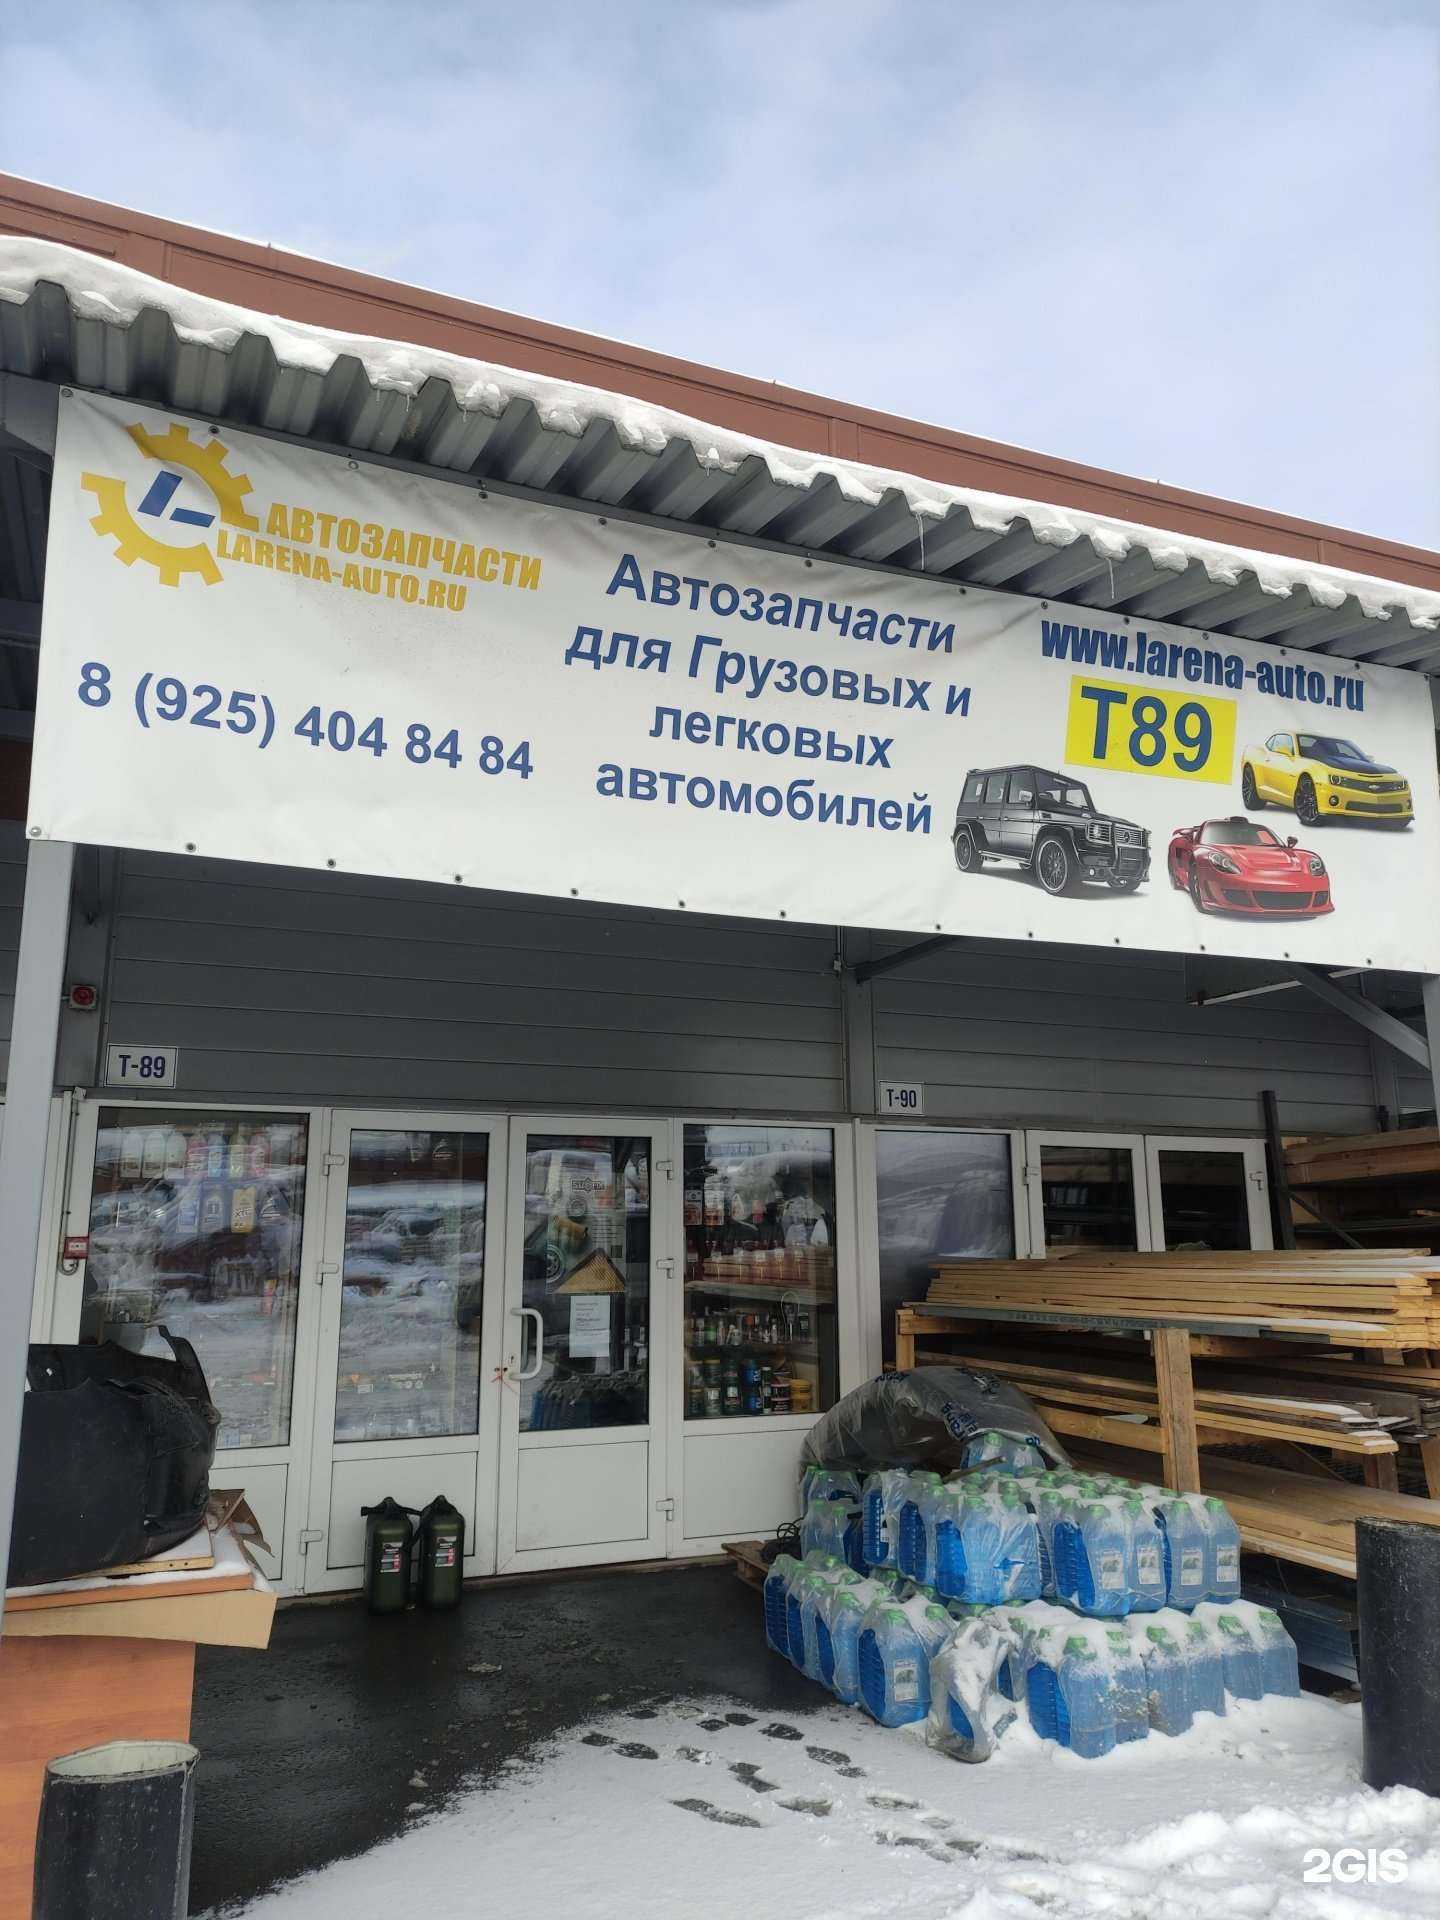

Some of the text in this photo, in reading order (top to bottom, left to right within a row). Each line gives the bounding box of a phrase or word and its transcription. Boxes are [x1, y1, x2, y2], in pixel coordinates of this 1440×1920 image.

[216, 530, 468, 612] LARENA-AUTO.RU
[267, 503, 542, 591] АВТОЗАПЧАСТИ
[608, 554, 955, 651] Автозапчасти
[565, 626, 971, 717] для Грузовых и
[1042, 620, 1365, 712] www.larena-auto.ru
[78, 662, 534, 780] 8 (925) 404 84 84
[651, 706, 894, 770] легковых
[597, 763, 932, 833] автомобилей
